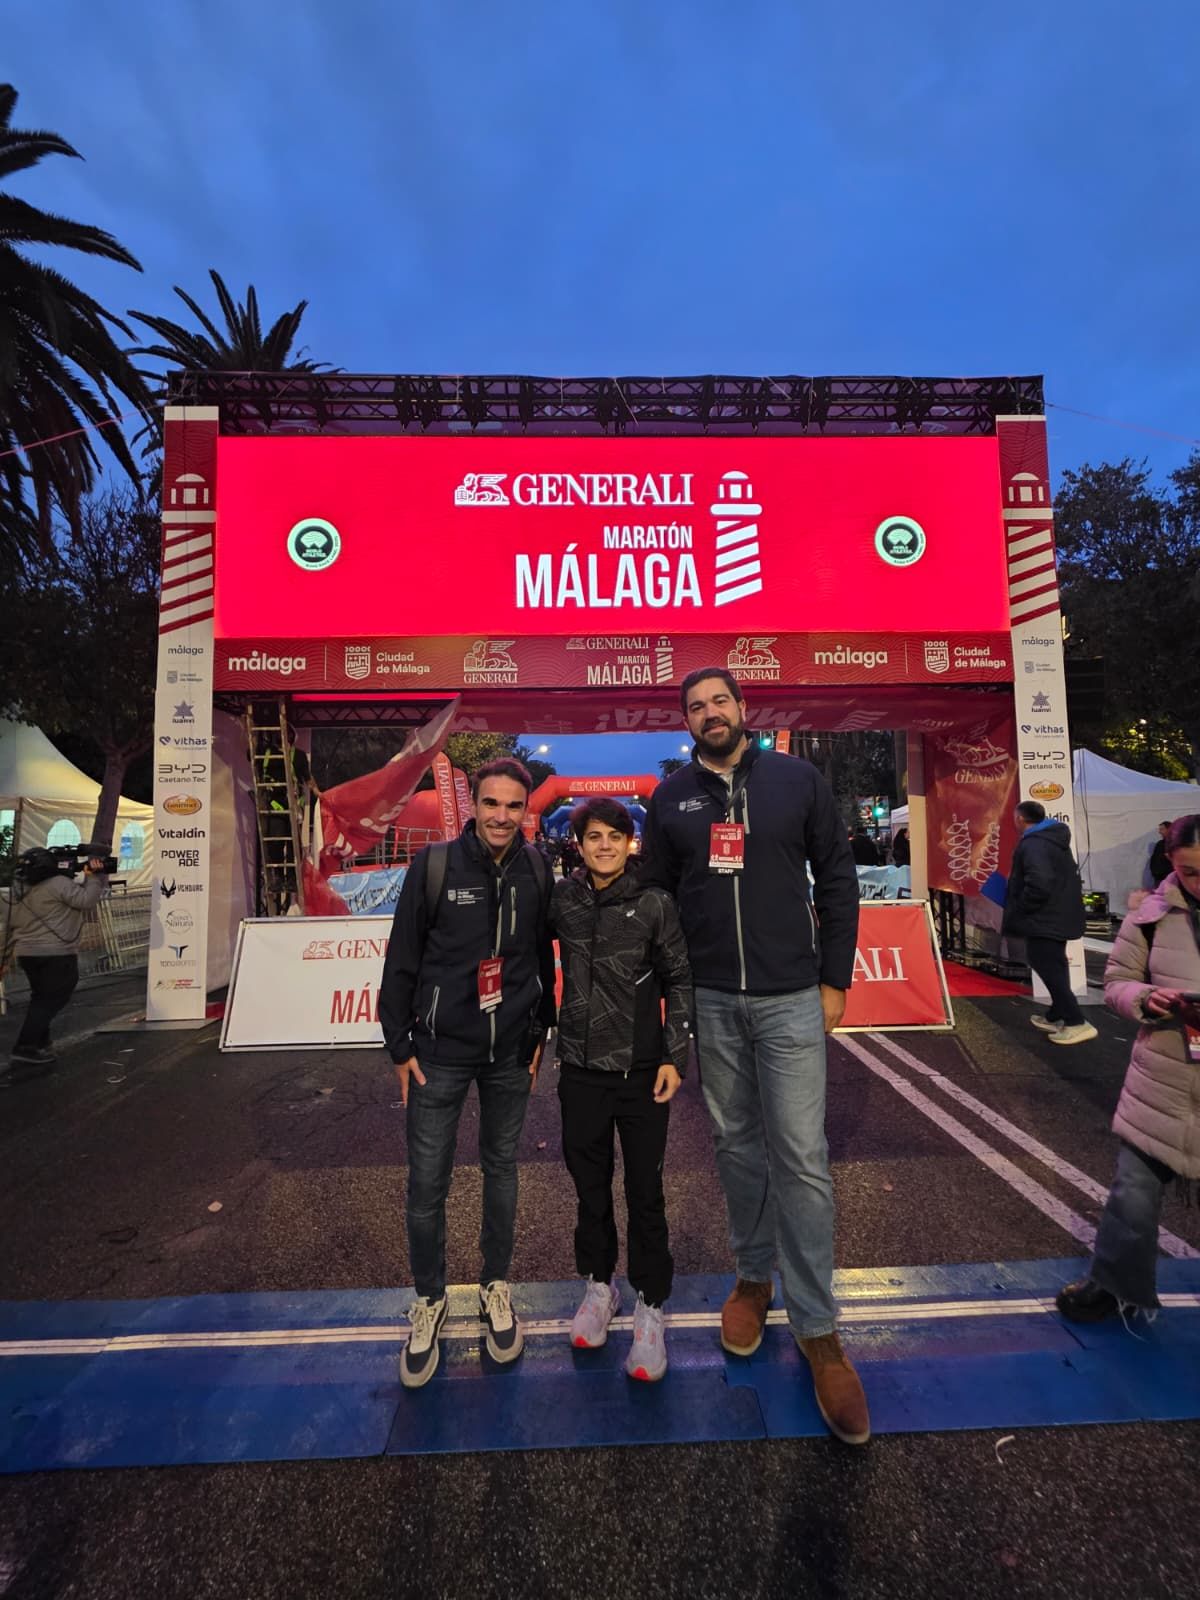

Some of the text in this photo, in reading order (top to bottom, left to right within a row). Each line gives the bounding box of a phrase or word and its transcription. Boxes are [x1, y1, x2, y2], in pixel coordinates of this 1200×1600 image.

[512, 473, 695, 506] GENERALI
[603, 521, 693, 549] MARATÓN
[515, 543, 703, 608] MÁLAGA
[586, 637, 649, 650] GENERALI
[376, 652, 414, 662] Ciudad
[953, 647, 990, 656] Ciudad
[617, 654, 650, 665] MARATÓN
[954, 658, 1006, 670] de Málaga
[376, 663, 430, 676] de Málaga
[587, 662, 652, 685] MÁLAGA
[464, 672, 518, 684] GENERALI
[1034, 725, 1065, 734] vithas
[174, 736, 207, 746] vithas
[1022, 751, 1066, 761] BYD
[158, 764, 206, 774] BYD
[585, 780, 636, 792] GENERALI
[161, 849, 200, 859] POWER
[178, 858, 200, 867] ADE
